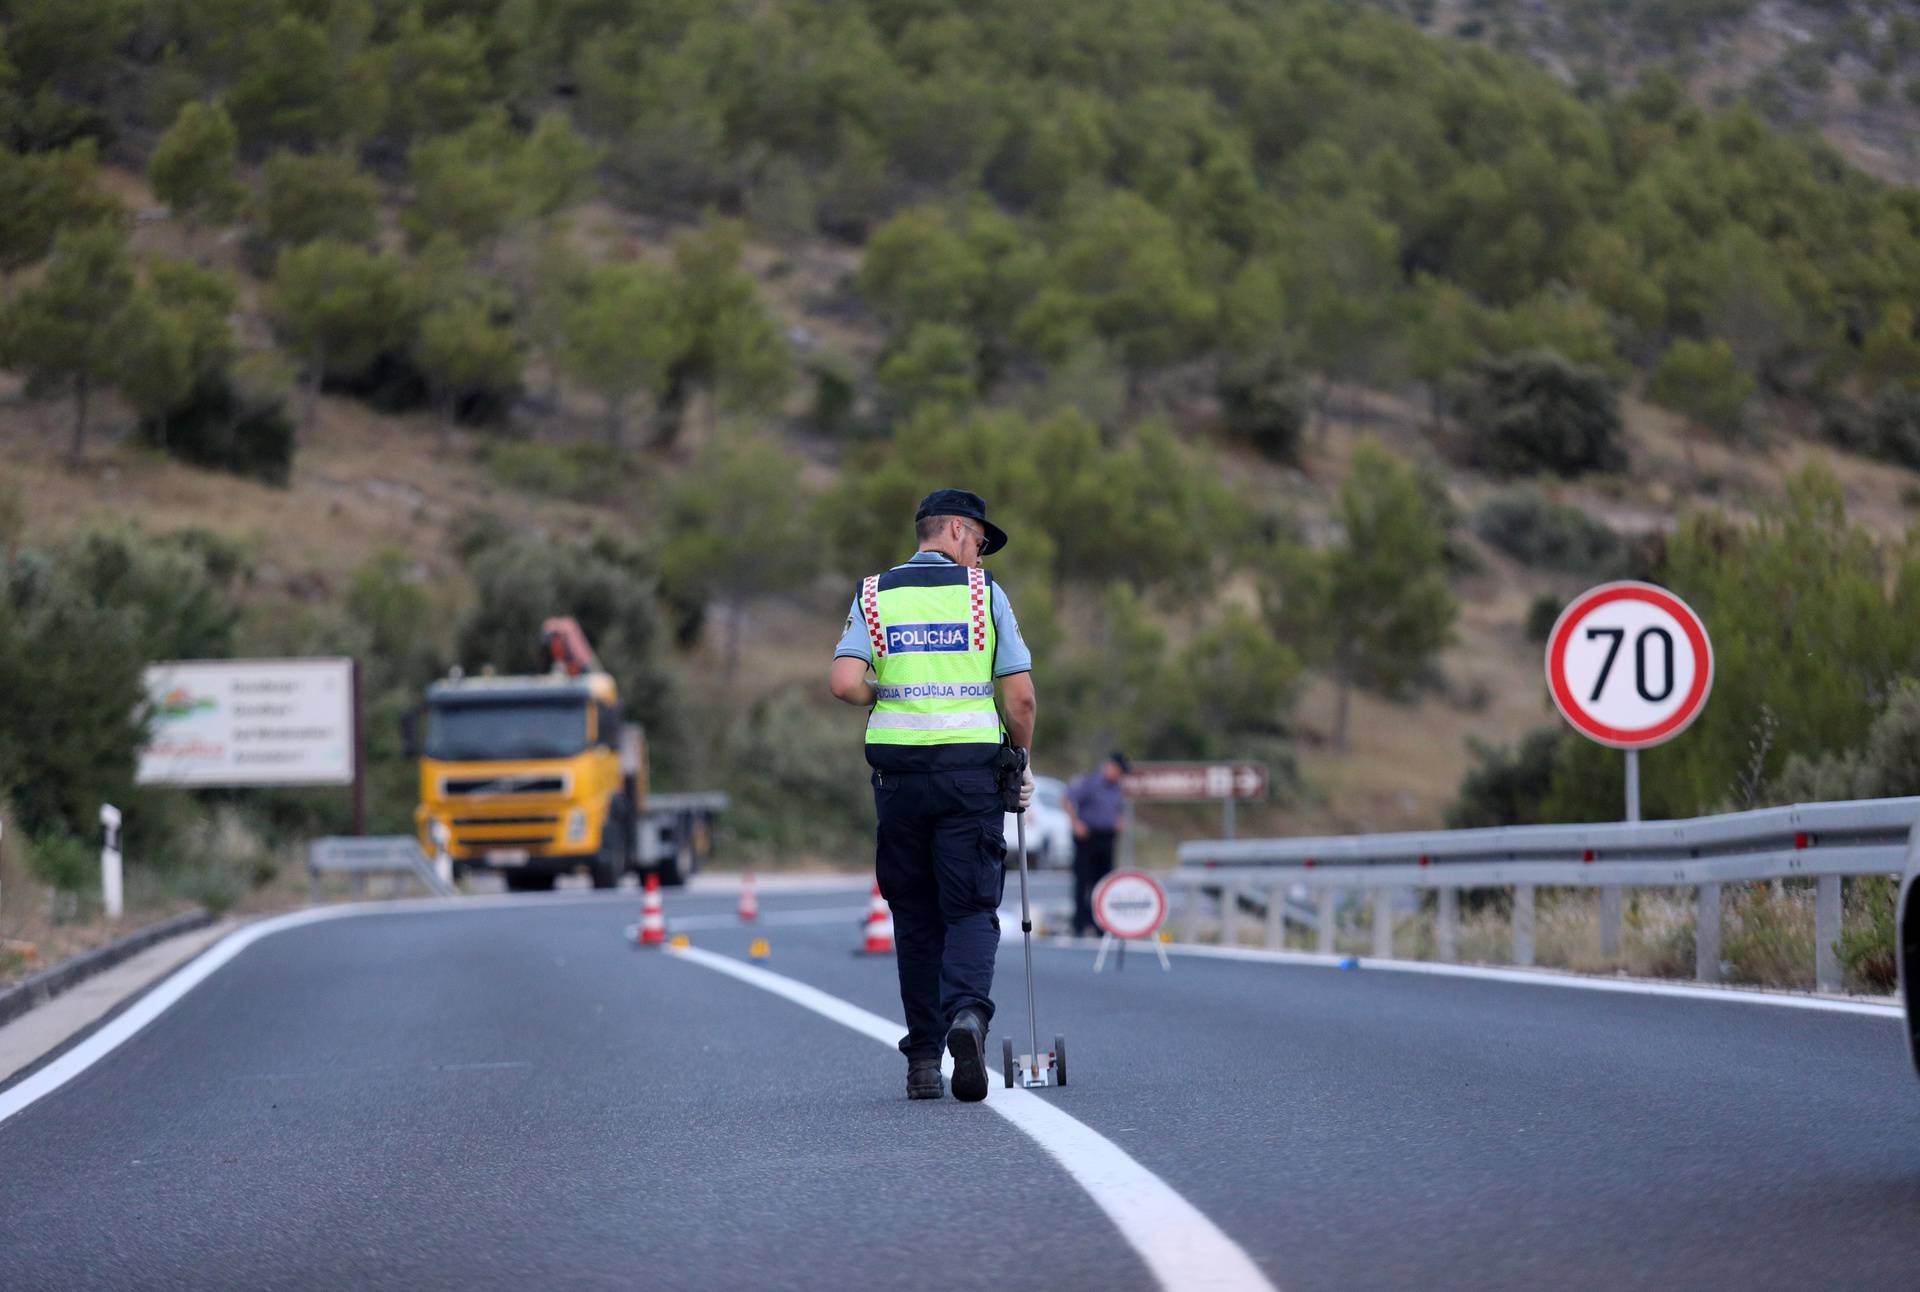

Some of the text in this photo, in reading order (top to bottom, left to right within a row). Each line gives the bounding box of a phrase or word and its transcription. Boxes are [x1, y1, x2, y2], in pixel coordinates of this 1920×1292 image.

[890, 630, 964, 646] POLICIJA
[1586, 626, 1674, 702] 70
[904, 685, 954, 698] POLICIJA
